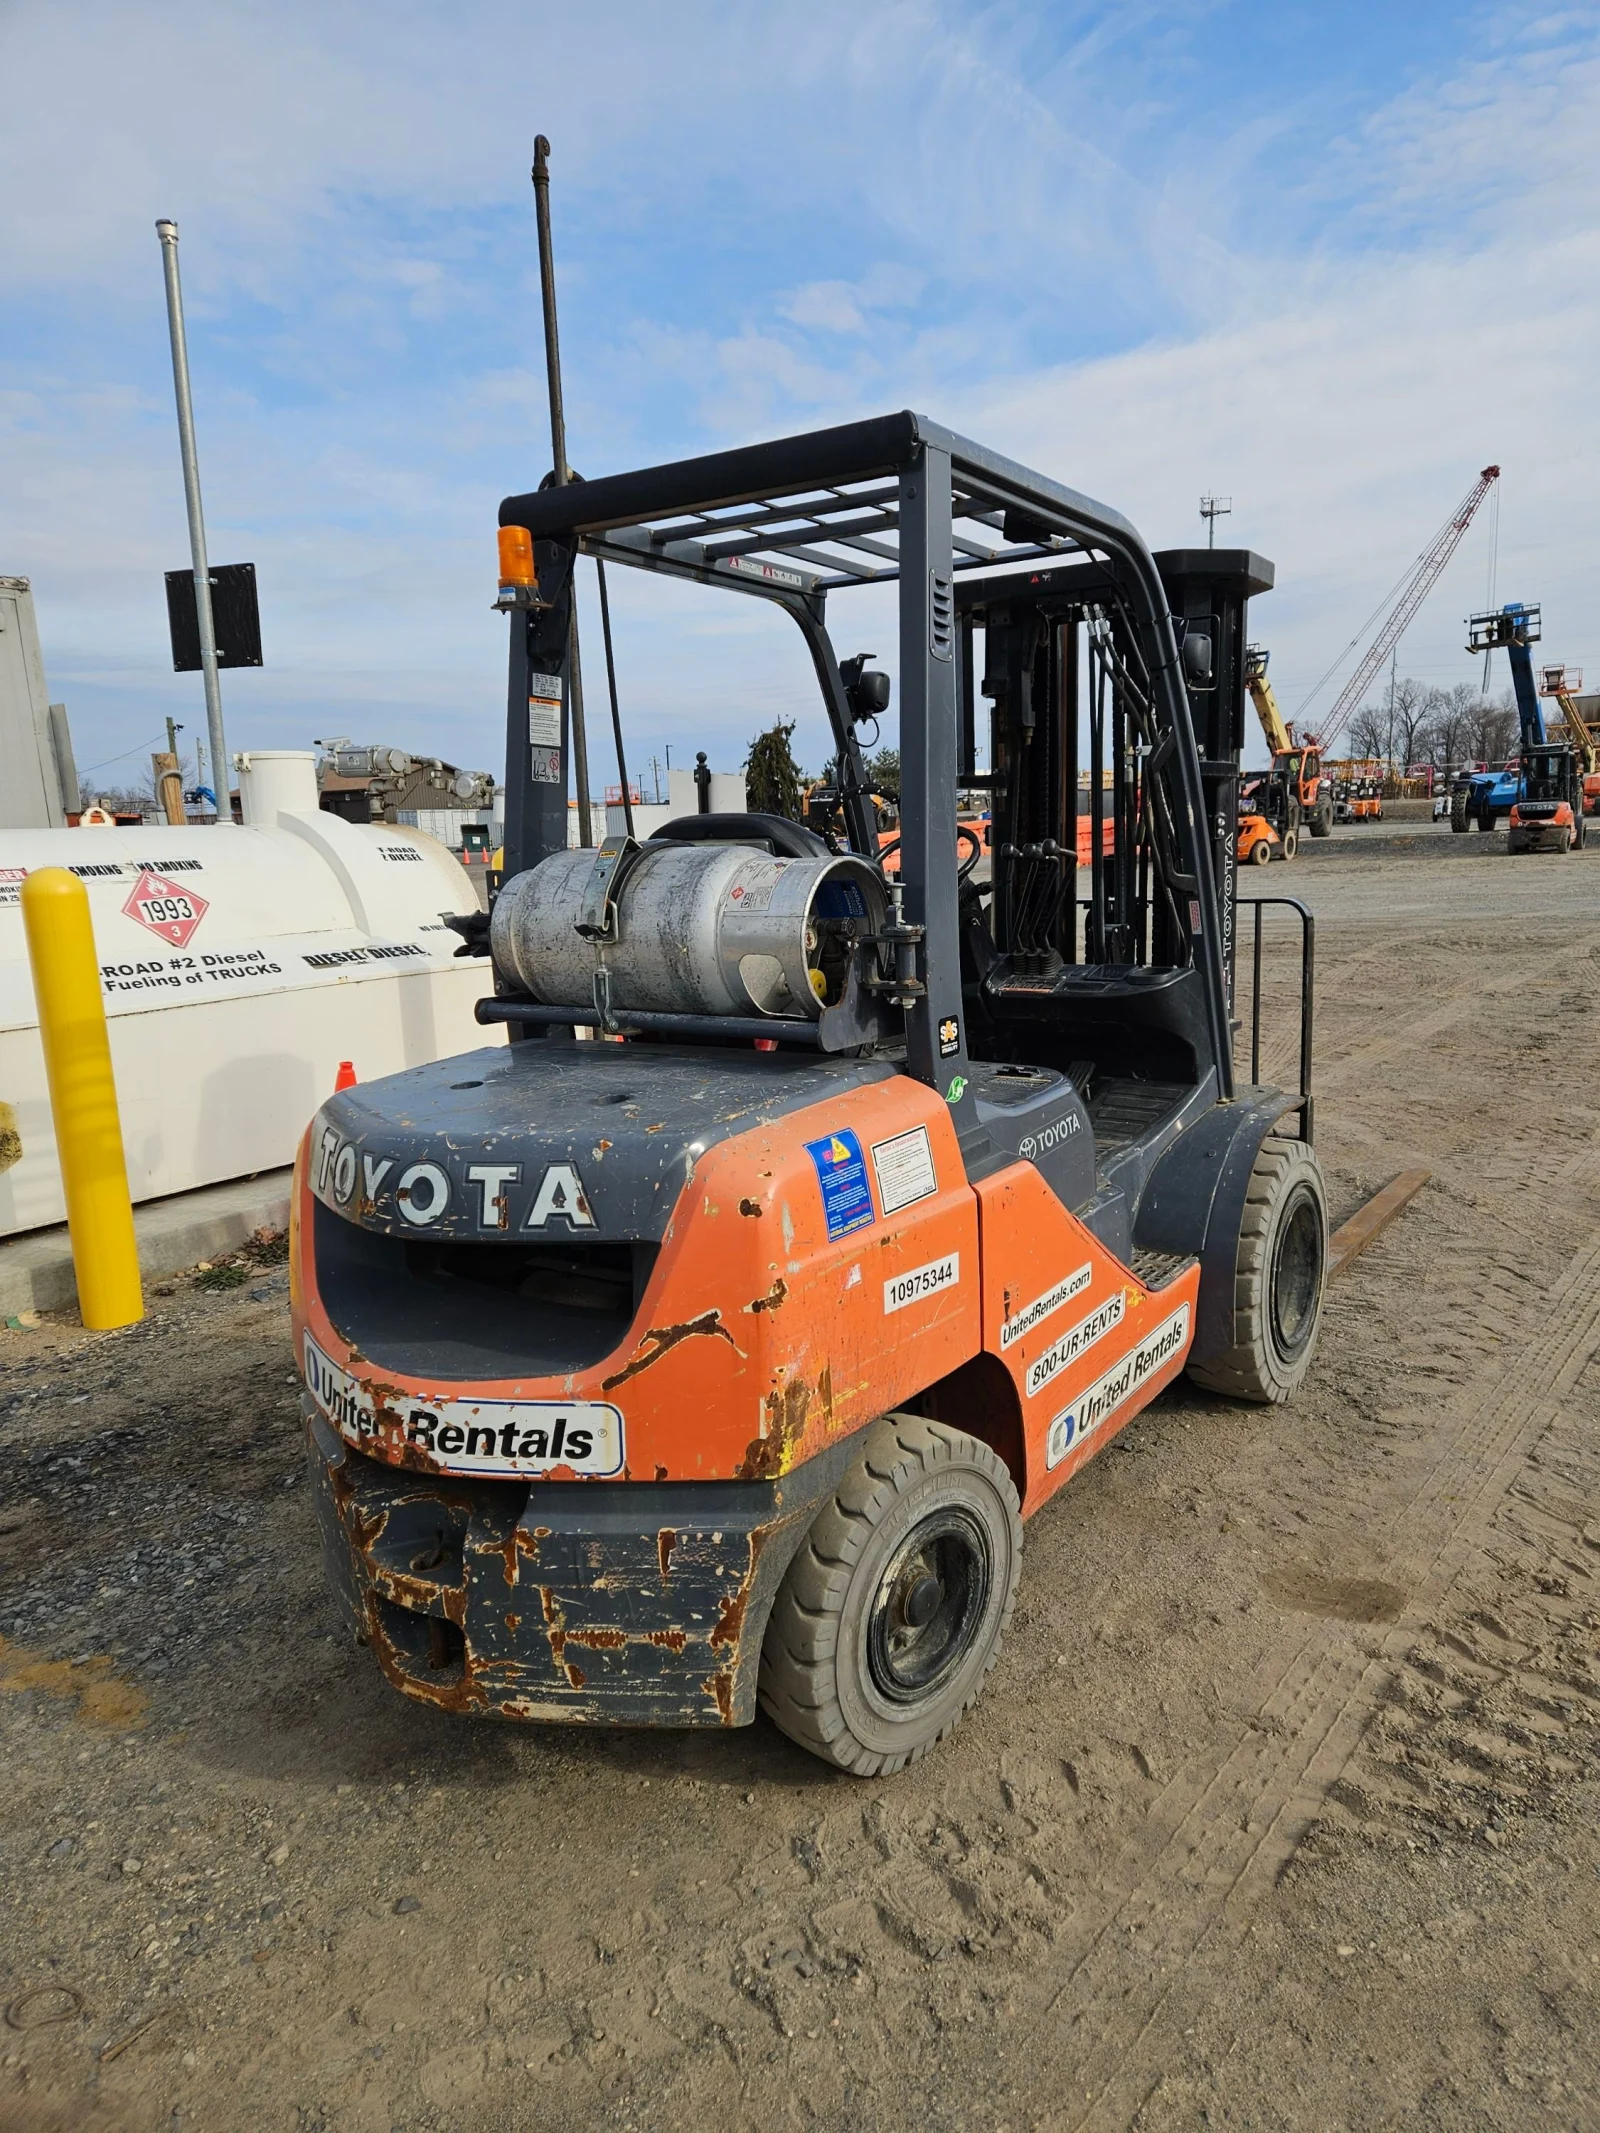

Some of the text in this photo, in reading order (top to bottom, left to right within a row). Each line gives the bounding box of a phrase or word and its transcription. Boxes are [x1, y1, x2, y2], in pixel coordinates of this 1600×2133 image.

[68, 864, 124, 878] SMOKING
[154, 860, 204, 873] SMOKING
[141, 897, 193, 922] 1993
[1223, 832, 1235, 957] TOYOTA
[171, 925, 181, 937] 3
[168, 957, 197, 970] #2
[199, 950, 266, 967] Diesel
[301, 944, 428, 966] DIESEL DIESEL
[104, 963, 282, 992] Fueling of TRUCKS
[1037, 1113, 1081, 1151] TOYOTA
[317, 1128, 597, 1229] TOYOTA
[890, 1262, 953, 1304] 10975344
[1003, 1270, 1090, 1345] UnitedRentals.com
[1032, 1299, 1121, 1387] 800-UR-RENTS
[1078, 1320, 1183, 1433] United Rentals
[407, 1411, 594, 1460] Rentals
